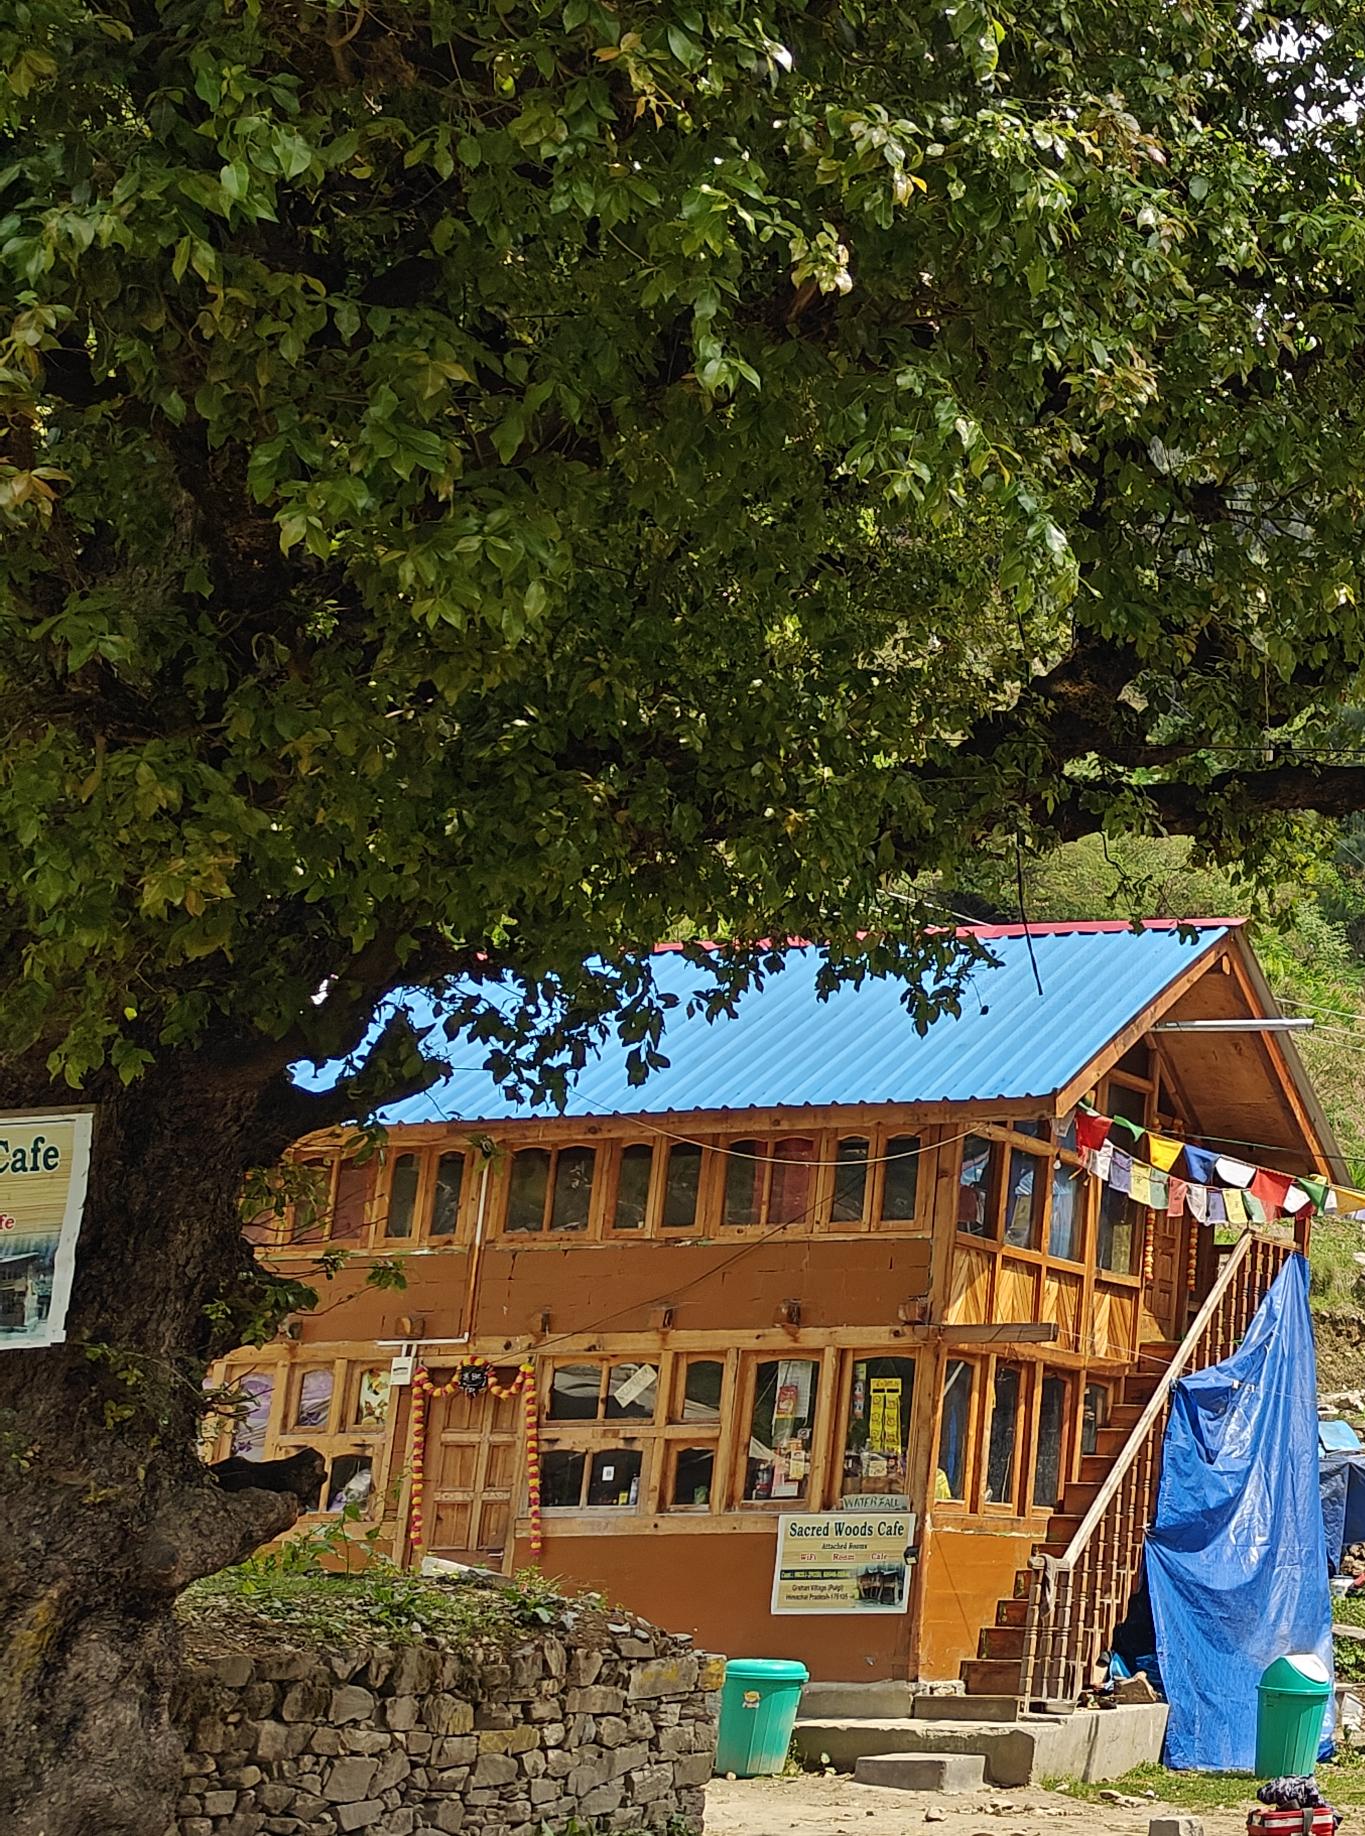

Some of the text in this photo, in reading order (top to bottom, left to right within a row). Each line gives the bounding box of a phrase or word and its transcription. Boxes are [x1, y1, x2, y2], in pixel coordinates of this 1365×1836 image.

[789, 1521, 904, 1537] Sacred Woods Cafe
